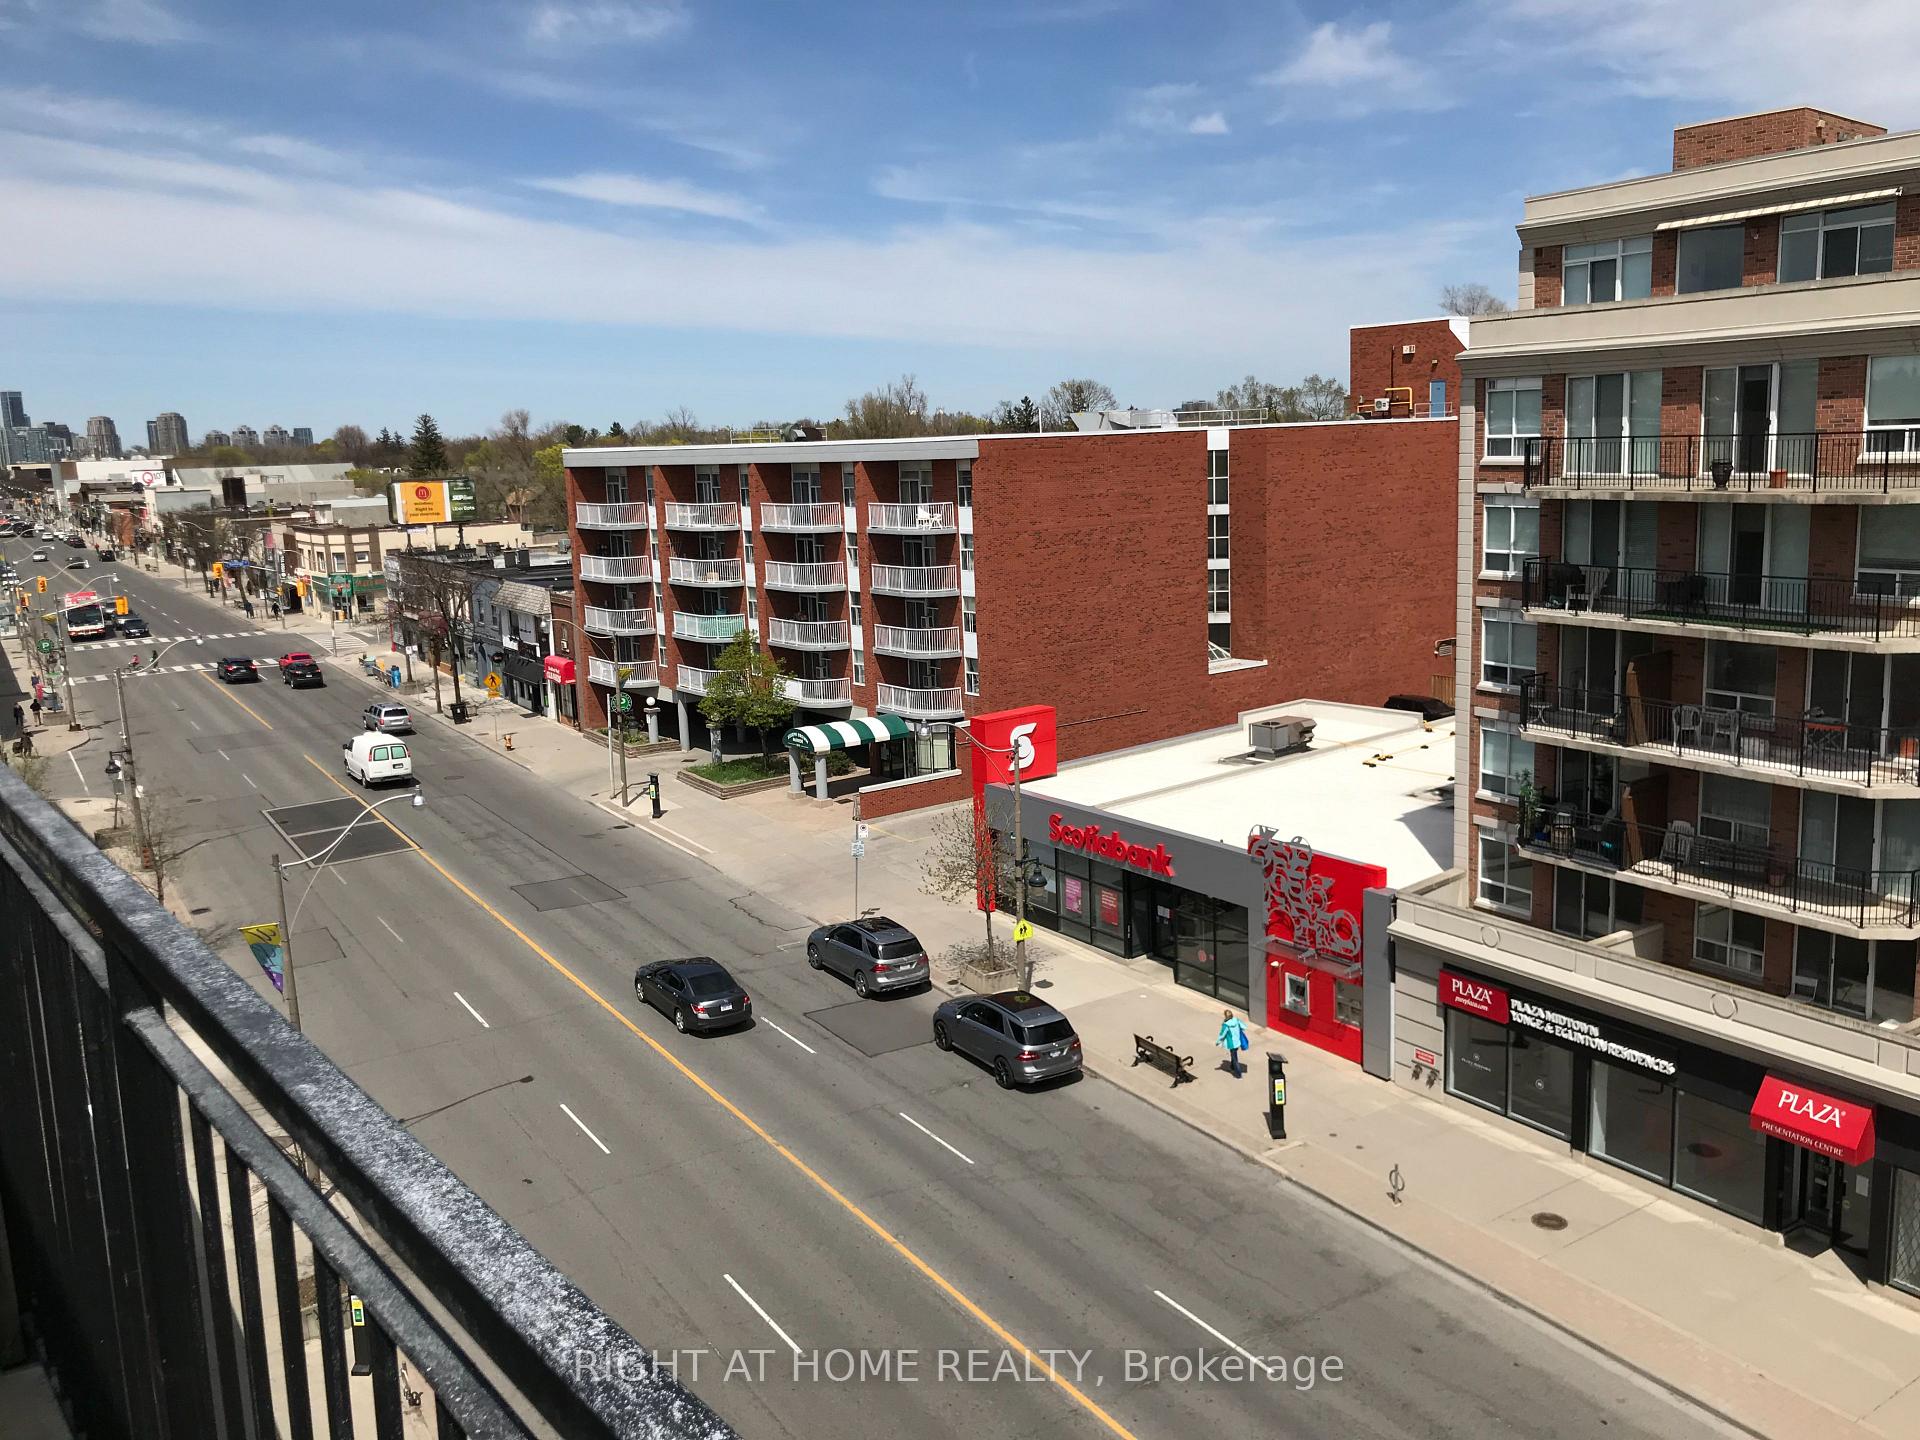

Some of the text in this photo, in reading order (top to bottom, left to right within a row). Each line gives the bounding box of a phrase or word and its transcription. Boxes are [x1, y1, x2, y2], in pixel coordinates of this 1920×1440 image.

[1048, 813, 1175, 877] Scotiabank
[1452, 978, 1492, 1005] PLAZA
[1510, 998, 1600, 1037] PLAZA MIDTOWN
[1510, 1009, 1676, 1076] YONGE & EGLINTON RESIDENCES
[1778, 1089, 1841, 1129] PLAZA
[1761, 1120, 1844, 1157] PRESENTATION CENTRE
